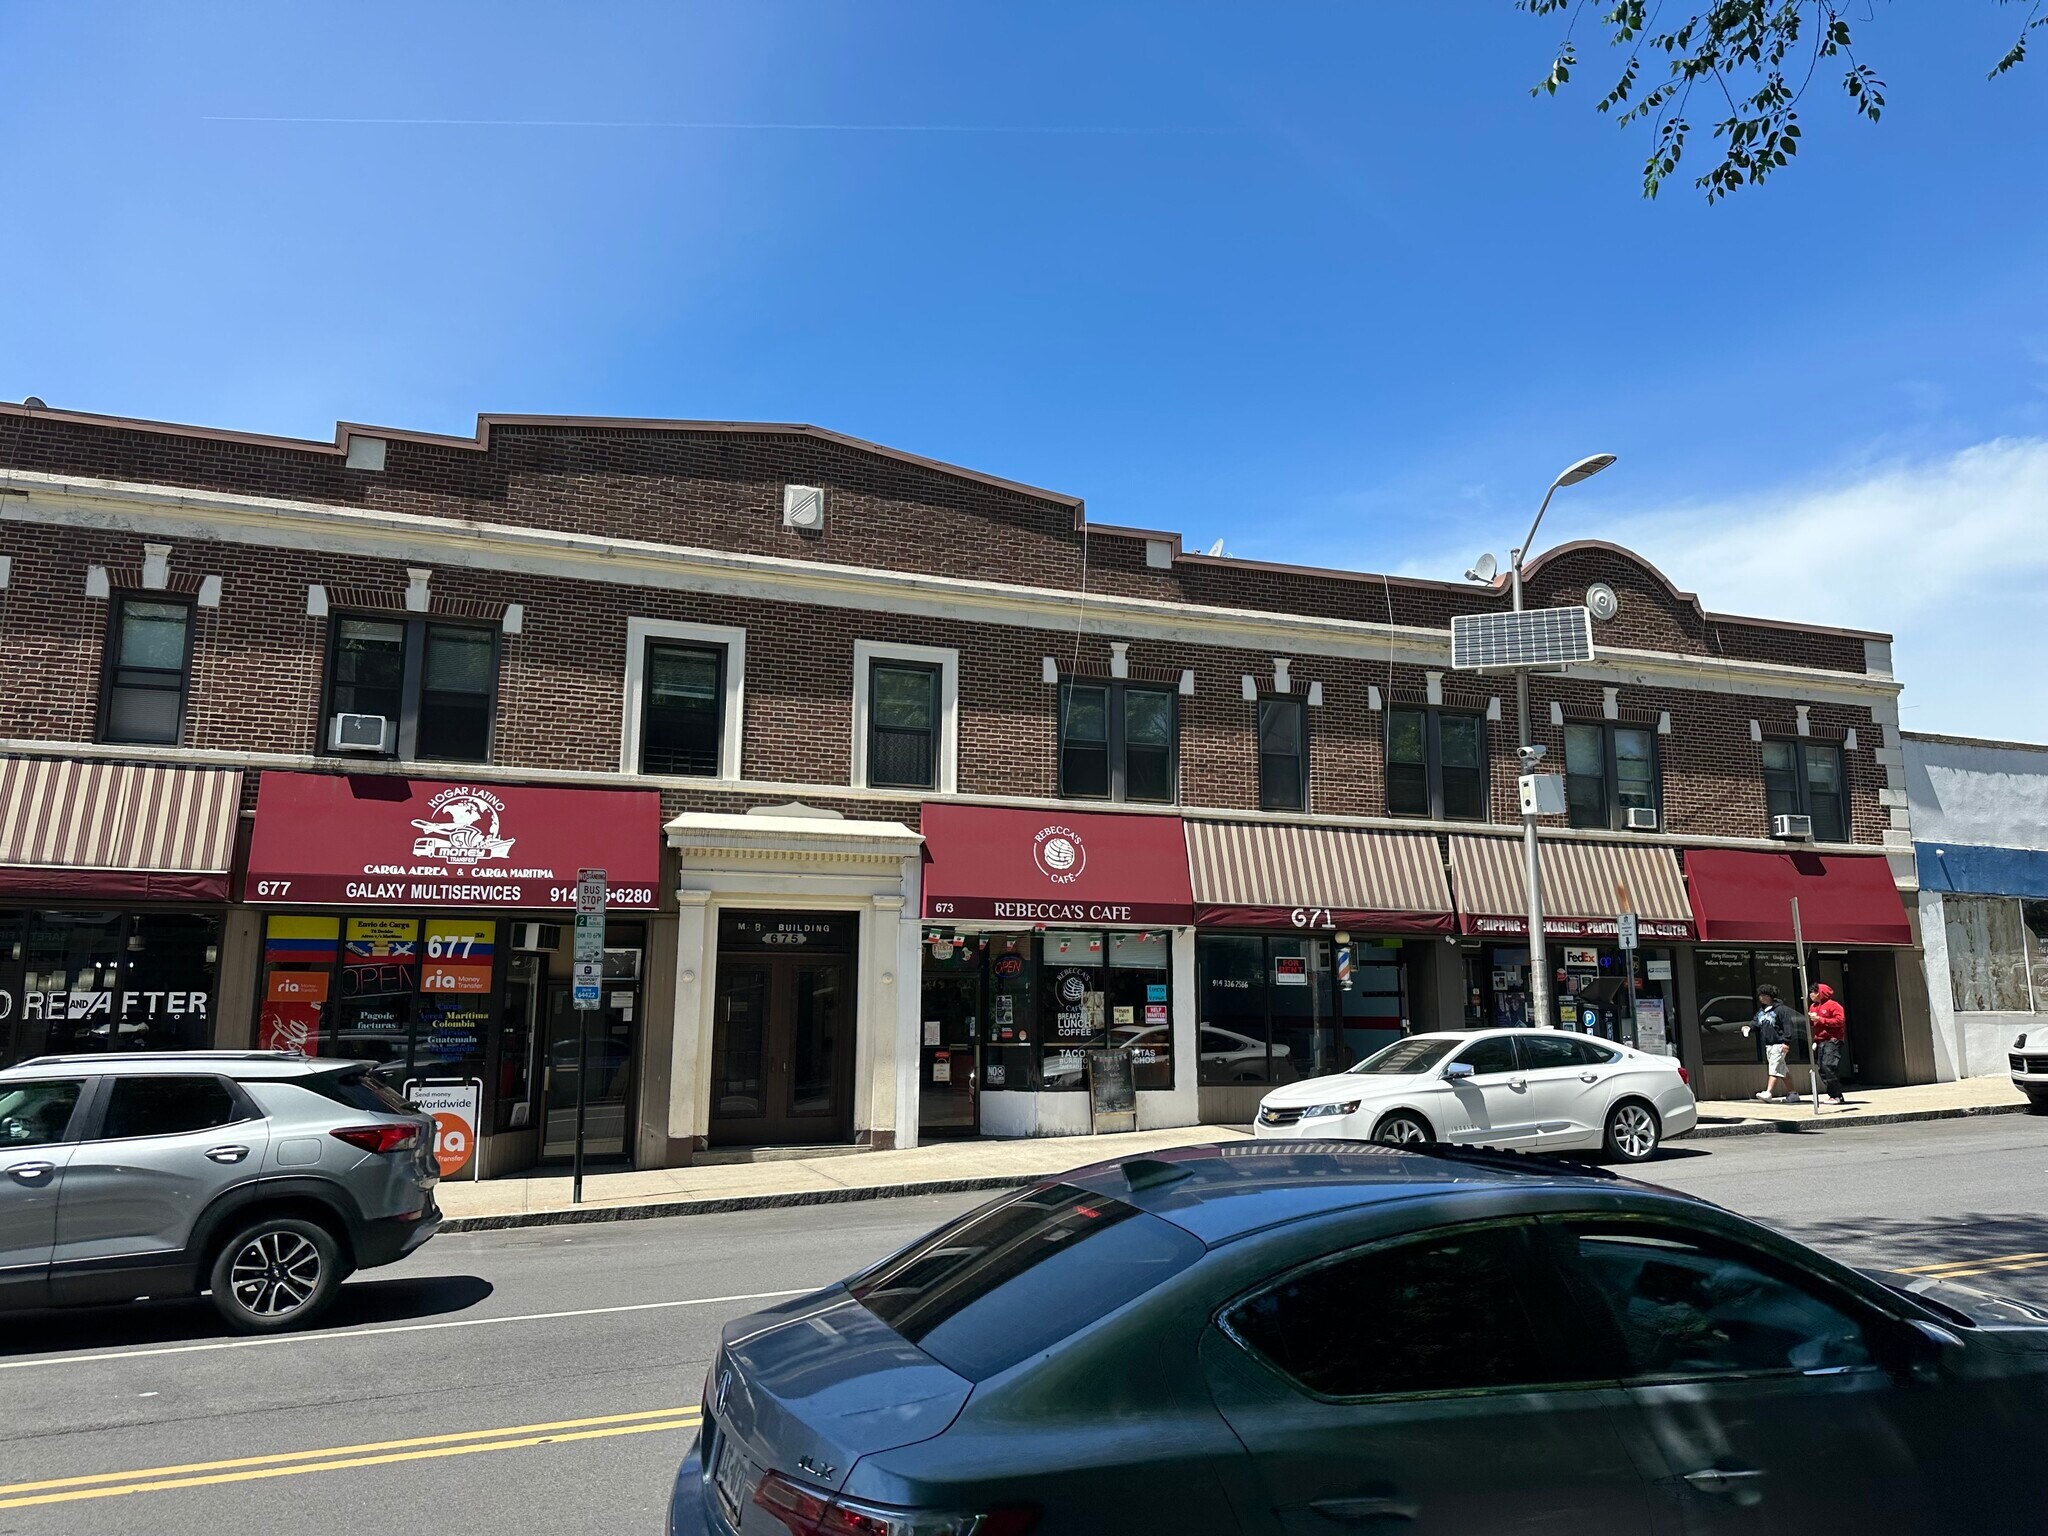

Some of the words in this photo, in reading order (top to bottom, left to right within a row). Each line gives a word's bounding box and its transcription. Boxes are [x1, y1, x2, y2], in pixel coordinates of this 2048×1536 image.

[427, 786, 469, 809] HOGAR
[472, 787, 505, 812] LATINO
[1034, 826, 1082, 845] REBECCA'S
[438, 848, 485, 857] MONEY
[363, 864, 405, 875] CARGA
[408, 866, 448, 876] AEREA
[456, 868, 464, 876] &
[471, 868, 508, 877] CARGA
[510, 869, 553, 878] MARITIMA
[1051, 872, 1076, 884] CAFÉ
[257, 881, 291, 896] 677
[346, 882, 406, 899] GALAXY
[410, 884, 521, 900] MULTISERVICES
[584, 886, 600, 895] BUS
[581, 896, 602, 904] STOP
[935, 903, 954, 913] 673
[994, 902, 1084, 919] REBECCA'S
[1090, 905, 1131, 920] CAFE
[579, 917, 585, 926] 2
[1291, 908, 1336, 928] 671
[390, 921, 410, 929] Carga
[779, 924, 830, 932] BUILDING
[1477, 919, 1521, 932] SHIPPING
[1543, 921, 1580, 933] KAGING
[1587, 922, 1619, 934] PRINTI
[1656, 924, 1687, 936] CENTER
[771, 934, 799, 944] 675
[428, 935, 475, 959] 677
[1567, 951, 1595, 962] FedEx
[994, 961, 1022, 975] OPEN
[1282, 959, 1300, 967] FOR
[1056, 967, 1091, 981] REBECCA'S
[1278, 966, 1304, 974] RENT
[342, 965, 413, 995] OPEN
[425, 969, 455, 989] ria
[1212, 979, 1222, 987] 914
[278, 979, 299, 992] ria
[70, 1000, 89, 1009] AND
[89, 991, 208, 1014] AFTER
[1066, 1003, 1083, 1012] CAF
[445, 1011, 489, 1020] Marítima
[1057, 1012, 1089, 1020] BREAKFAS
[1585, 1013, 1593, 1024] P
[357, 1021, 396, 1029] facturas
[432, 1020, 476, 1028] Colombia
[1057, 1019, 1092, 1029] LUNCH
[1058, 1028, 1092, 1036] COFFEE
[427, 1035, 478, 1043] Guatemala
[1133, 1056, 1156, 1064] CHOS
[988, 1066, 997, 1077] NO
[420, 1099, 471, 1108] Worldwide
[433, 1121, 465, 1152] ia
